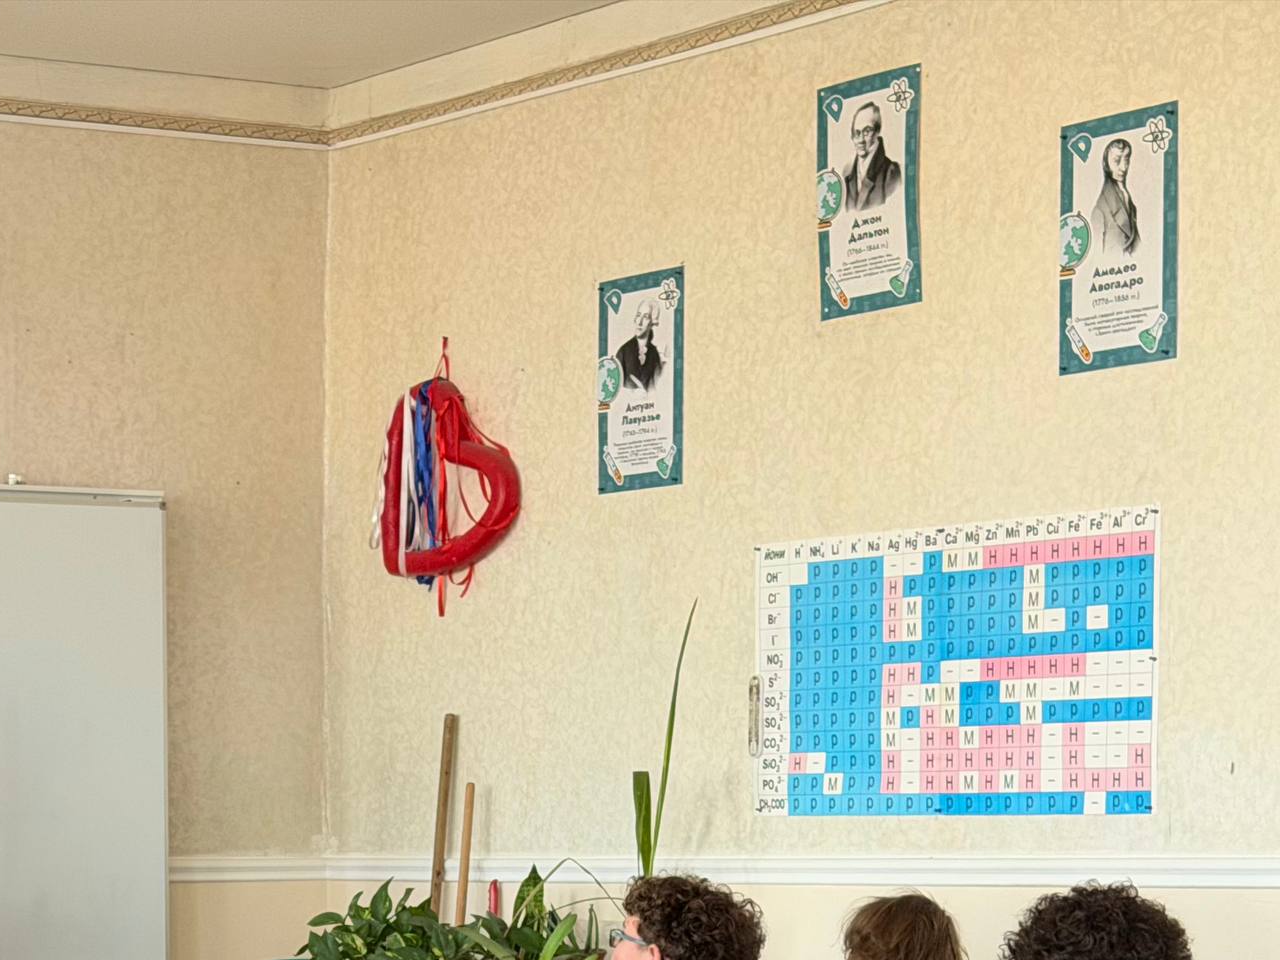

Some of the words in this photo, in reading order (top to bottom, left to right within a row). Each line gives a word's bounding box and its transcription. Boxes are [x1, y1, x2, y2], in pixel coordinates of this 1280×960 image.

[852, 216, 882, 230] Джон
[848, 227, 889, 244] Дальтон
[1093, 263, 1137, 278] Амедео
[1089, 277, 1144, 293] Авогадро
